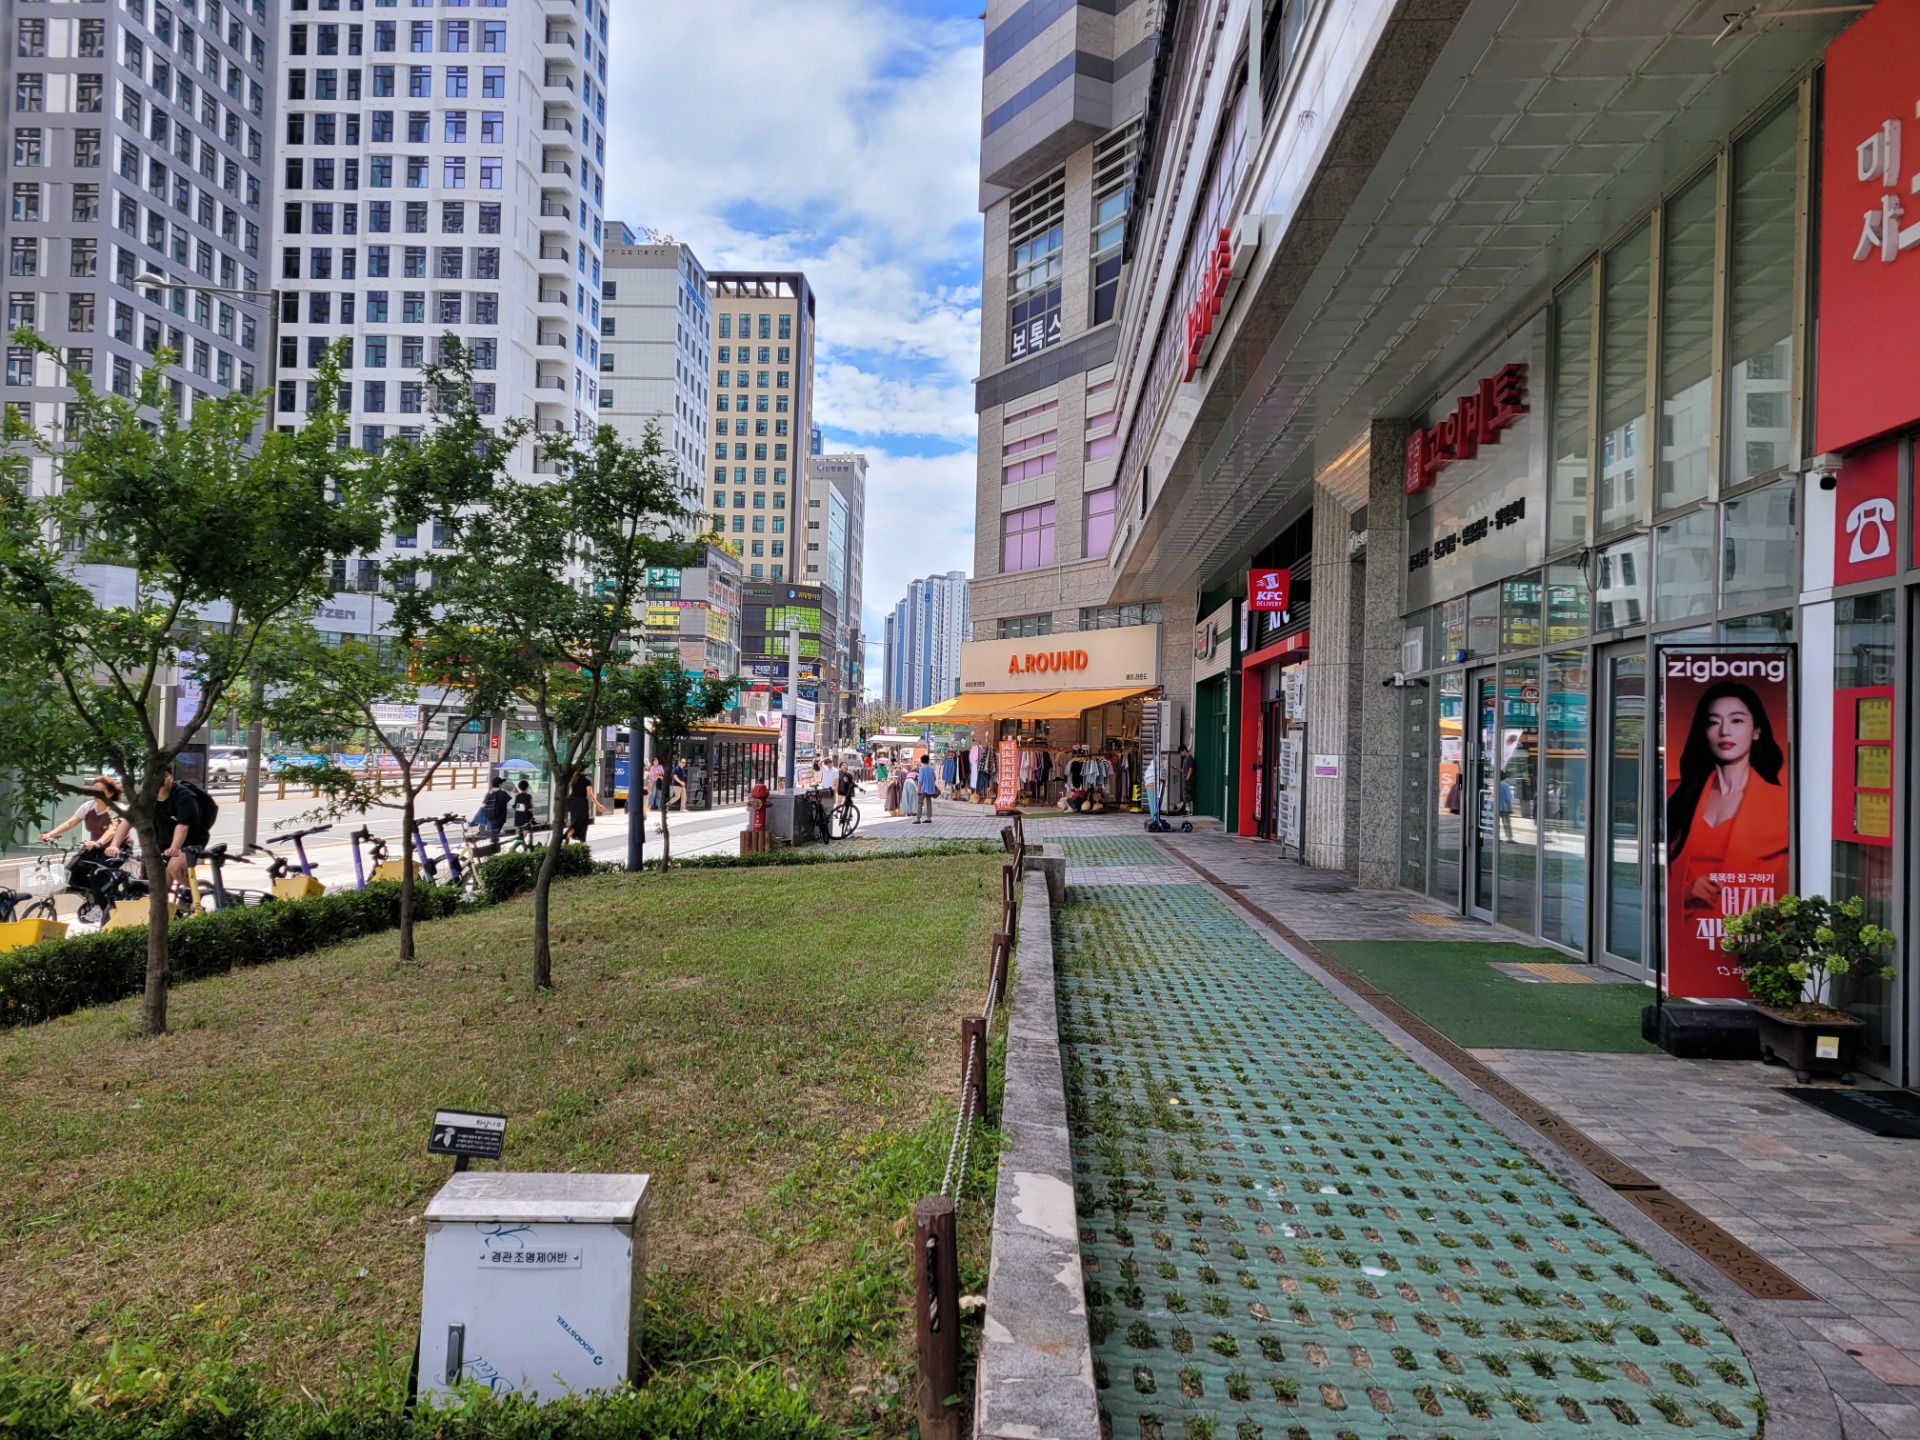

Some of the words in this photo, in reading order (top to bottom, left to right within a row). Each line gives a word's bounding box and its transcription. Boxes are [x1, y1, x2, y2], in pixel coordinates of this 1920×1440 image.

[1011, 313, 1061, 358] 보톡스
[1256, 591, 1283, 601] KFC
[1008, 650, 1089, 674] A.ROUND
[1668, 656, 1785, 682] zigbang
[491, 738, 498, 747] 5
[1001, 742, 1015, 750] SALE
[1001, 750, 1015, 758] SALE
[1001, 765, 1015, 773] SALE
[1001, 780, 1015, 788] SALE
[1000, 787, 1015, 795] SALE
[1709, 872, 1736, 883] 똑똑한
[1737, 872, 1747, 883] 집
[1748, 872, 1775, 883] 구하기
[490, 1250, 568, 1264] 경관조명제어반
